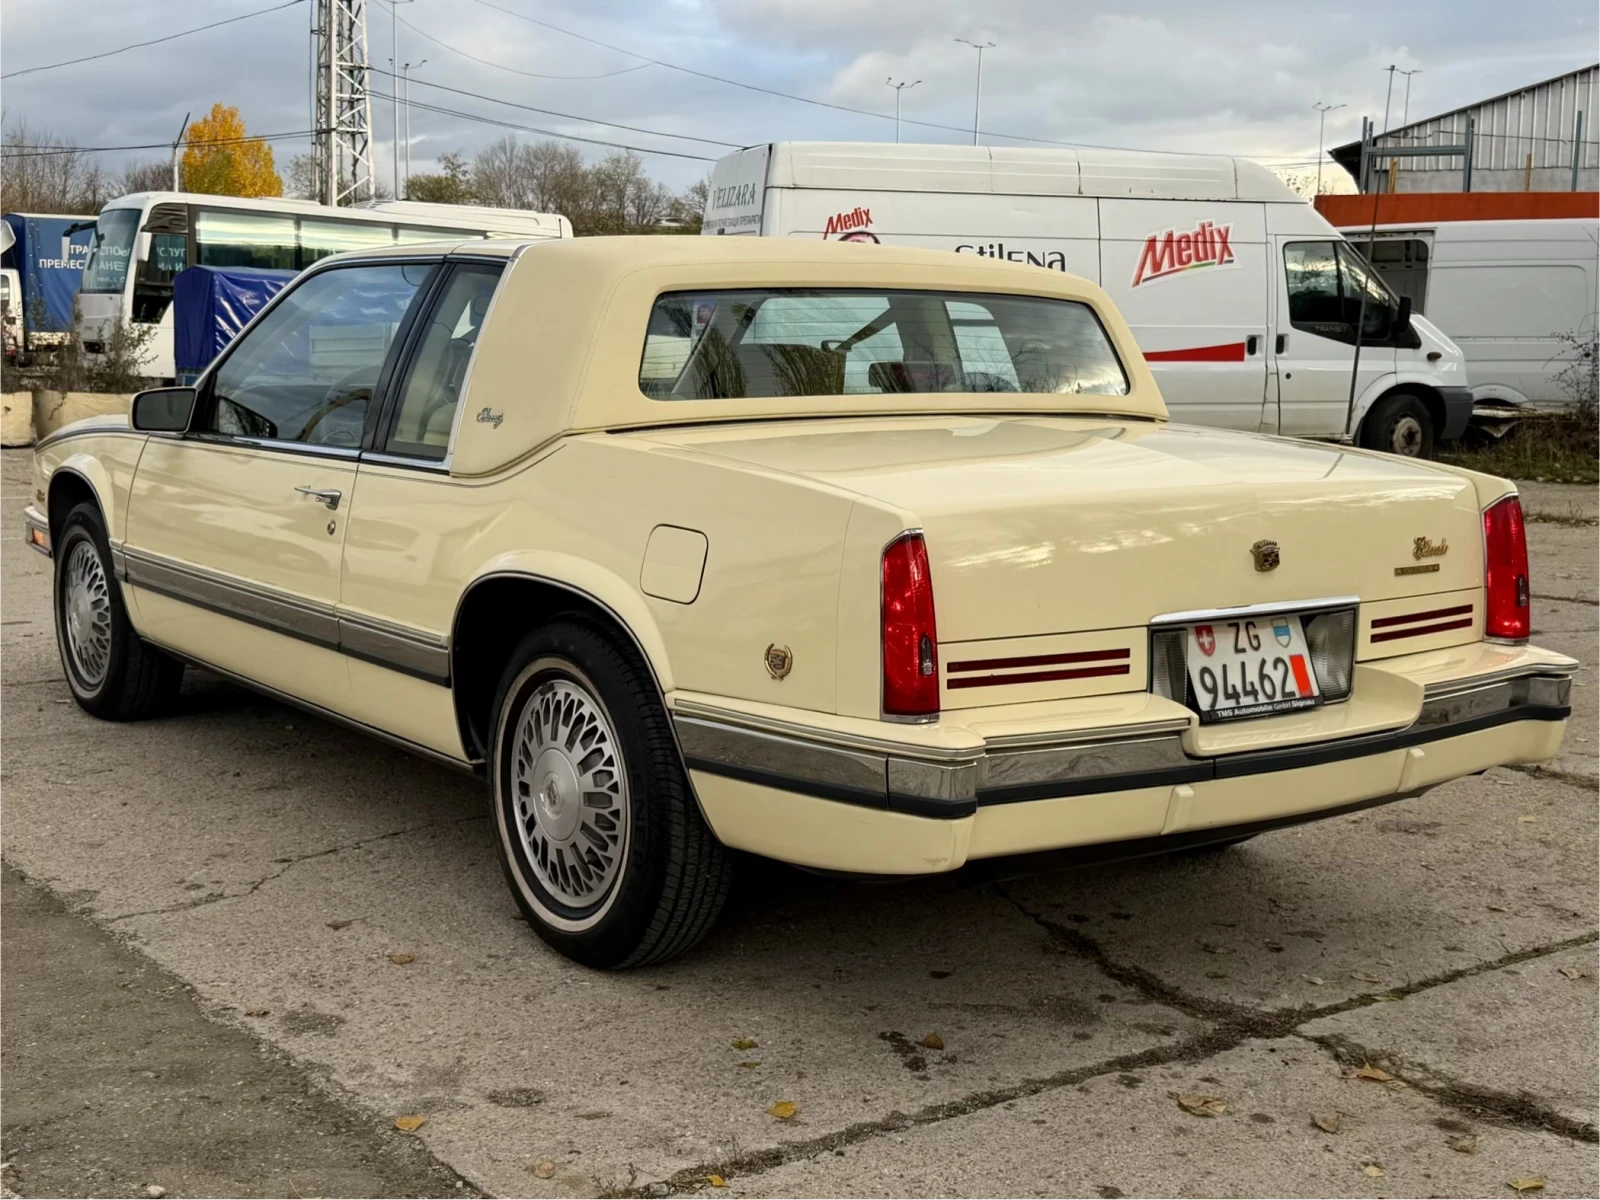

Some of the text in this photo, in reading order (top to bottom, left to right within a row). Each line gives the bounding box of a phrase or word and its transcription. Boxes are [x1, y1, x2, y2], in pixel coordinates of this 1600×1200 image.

[712, 182, 756, 210] VELIZARA
[823, 206, 873, 240] Medix
[1132, 220, 1235, 288] Medix
[1228, 620, 1261, 654] ZG
[1200, 657, 1296, 709] 94462
[1216, 708, 1233, 718] TMS
[1234, 704, 1273, 716] Automobile
